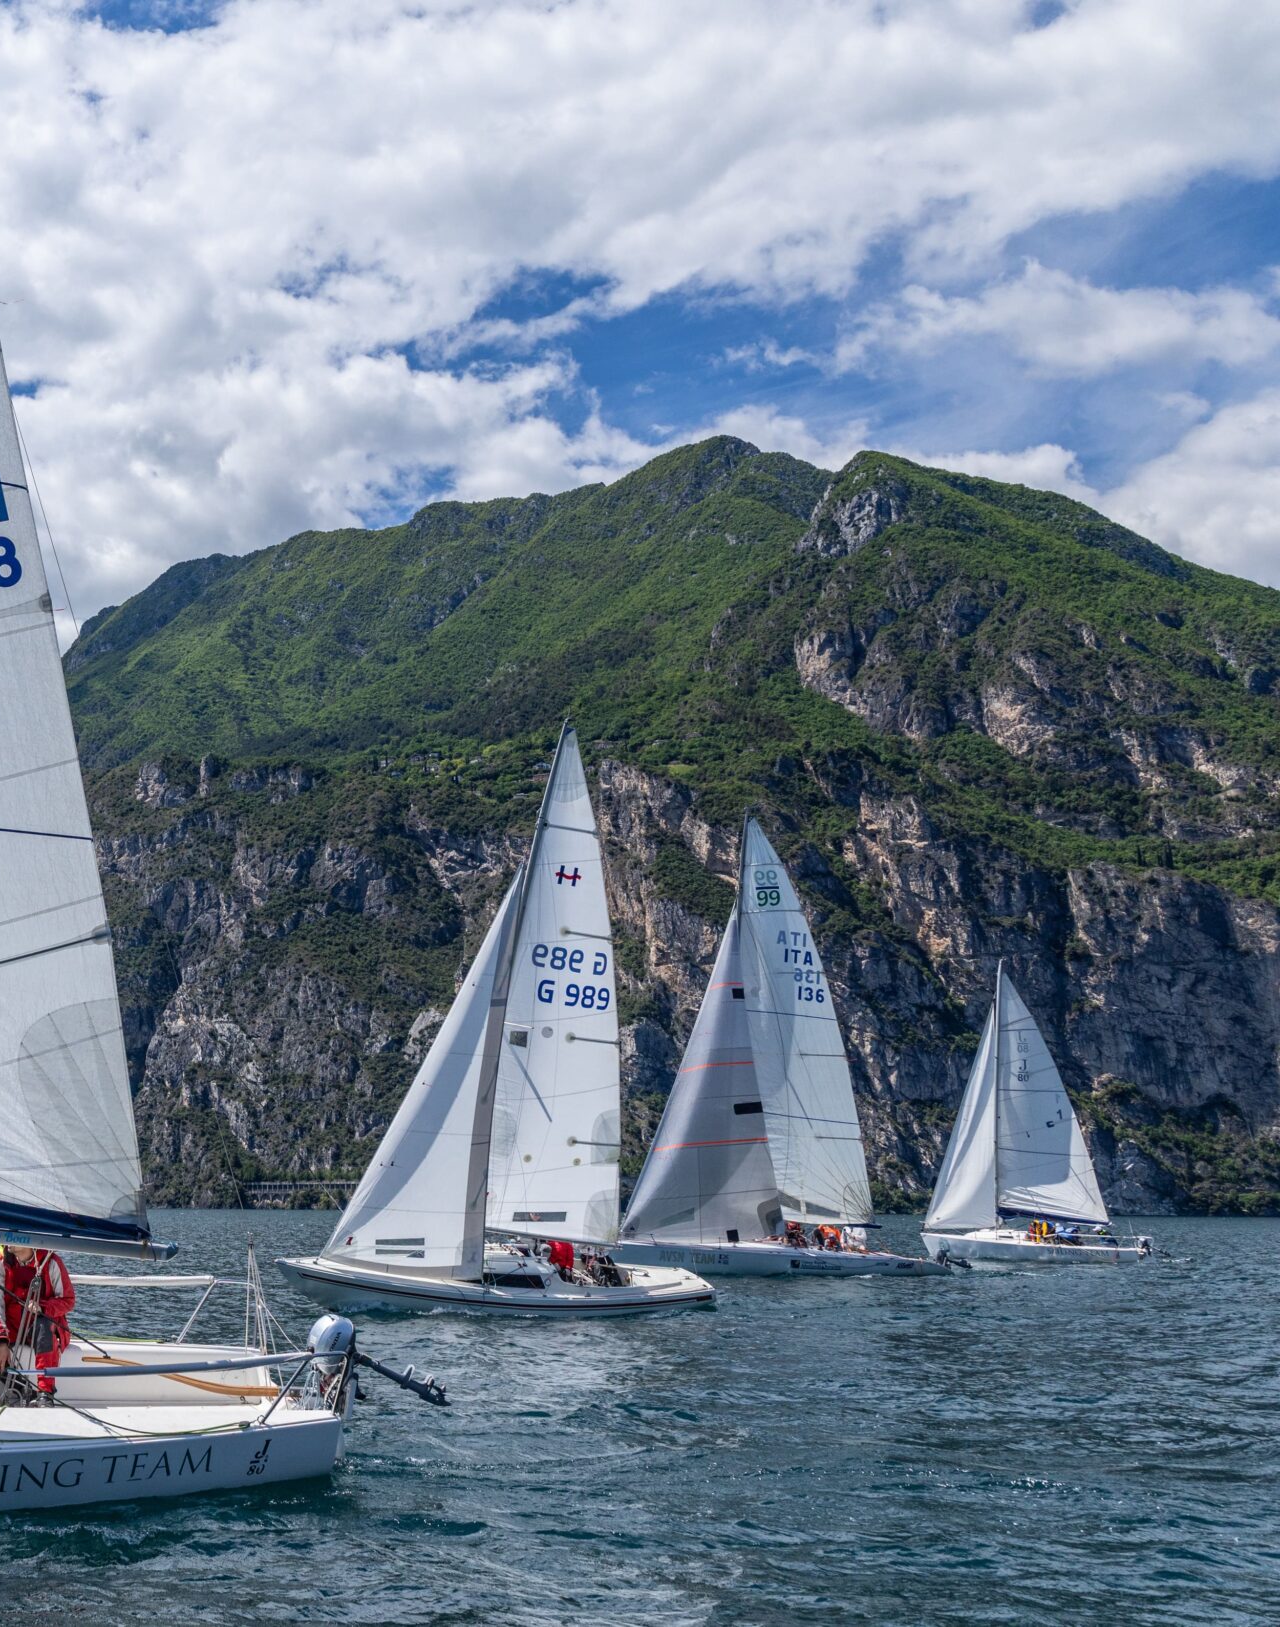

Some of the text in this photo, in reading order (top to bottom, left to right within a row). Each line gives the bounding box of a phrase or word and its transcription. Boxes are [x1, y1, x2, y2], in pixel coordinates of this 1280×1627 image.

[756, 890, 780, 907] 99
[784, 948, 813, 966] ITA
[537, 979, 610, 1011] G 989
[797, 986, 825, 1003] 136
[1017, 1073, 1030, 1082] 80
[4, 1231, 32, 1244] Boat
[688, 1251, 716, 1265] TEAM
[254, 1438, 272, 1459] J
[101, 1445, 213, 1484] TEAM
